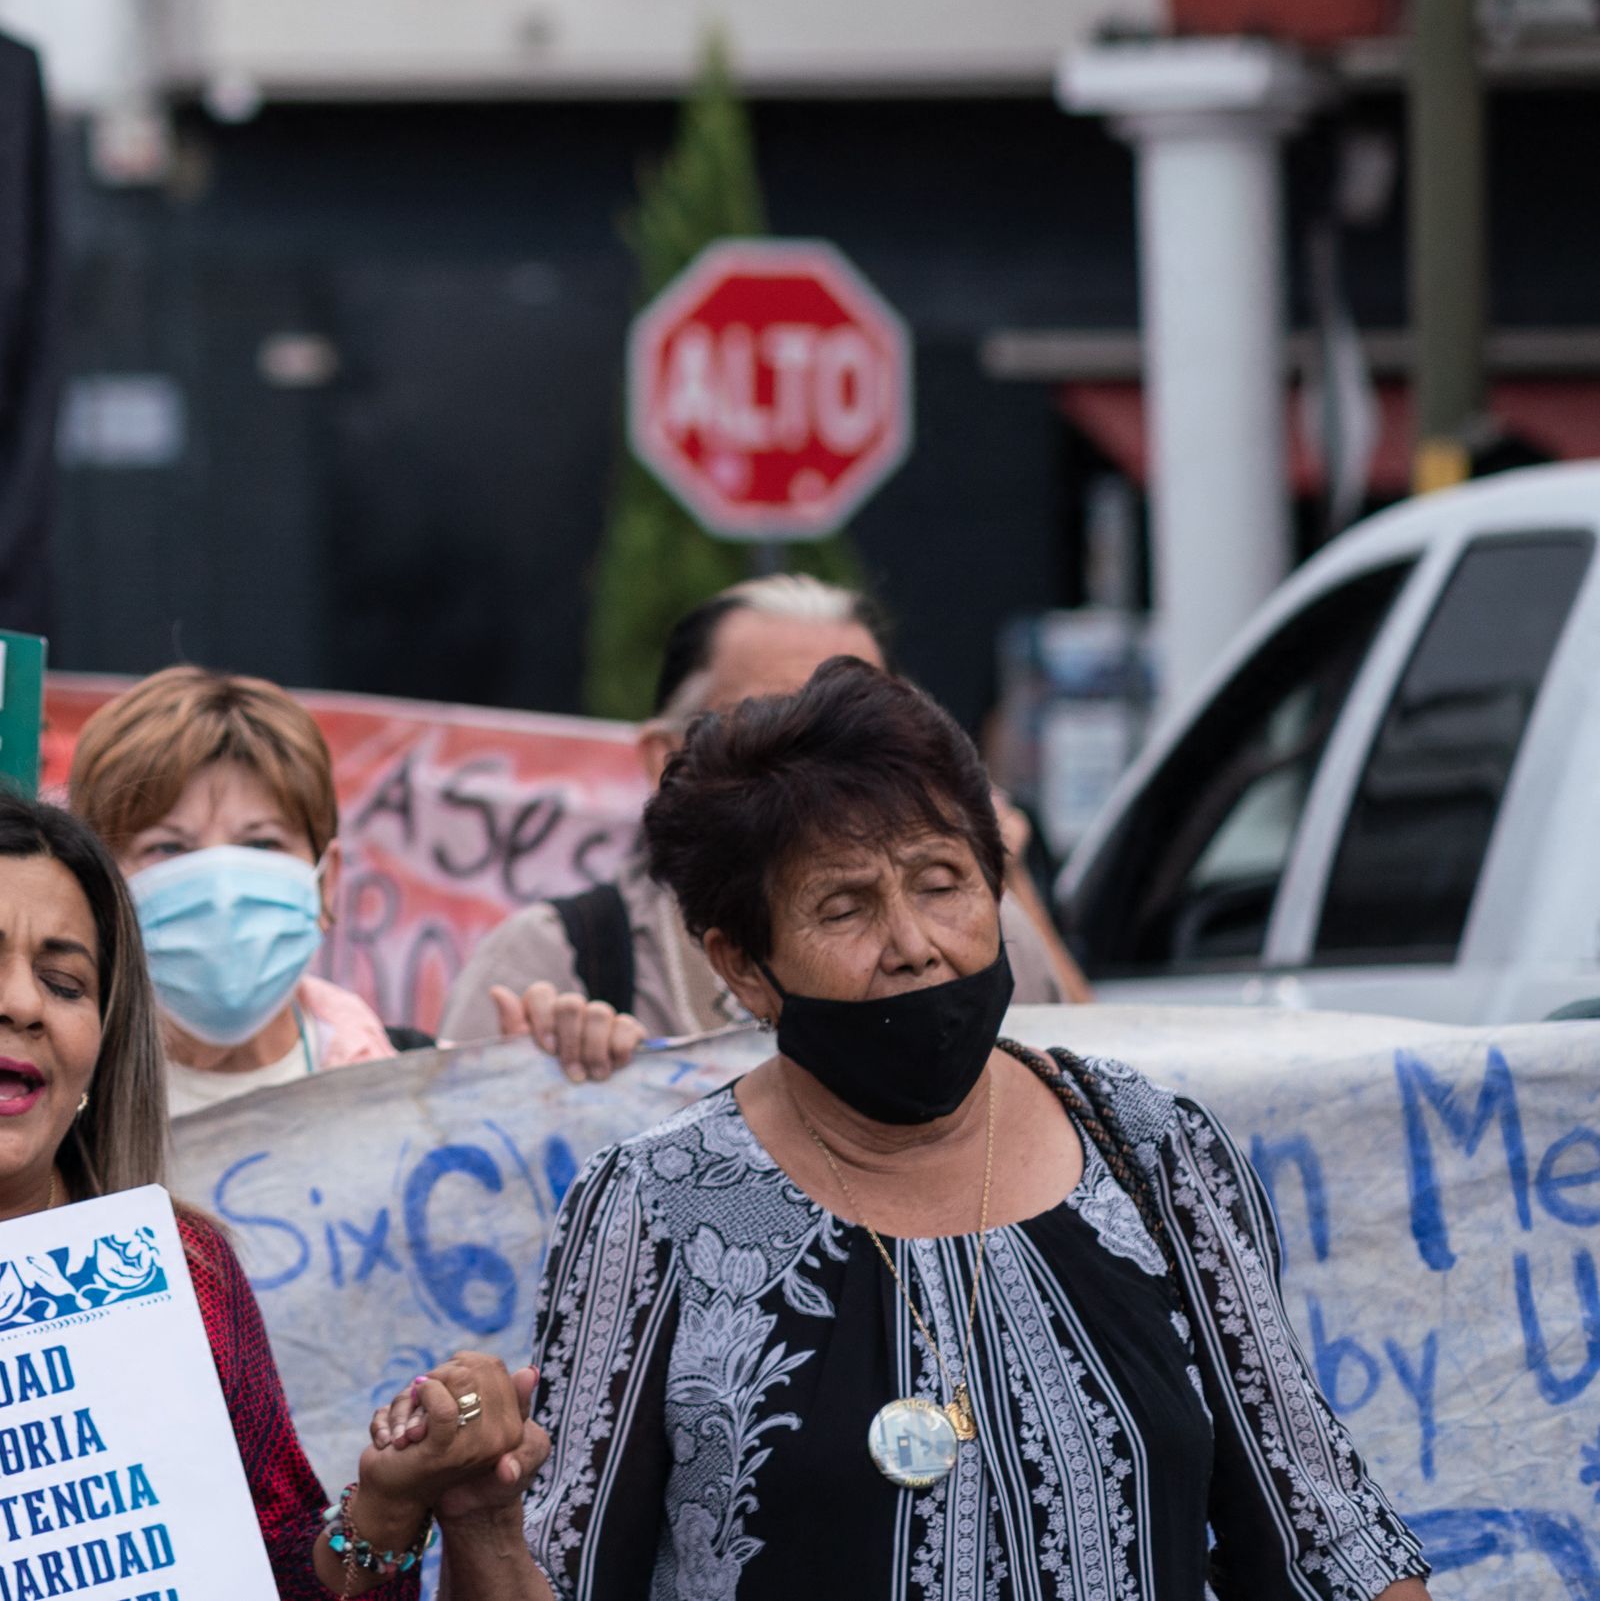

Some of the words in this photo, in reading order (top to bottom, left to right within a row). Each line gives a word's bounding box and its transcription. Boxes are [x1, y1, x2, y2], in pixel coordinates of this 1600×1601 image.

[666, 321, 882, 453] ALTO
[213, 1150, 402, 1291] Six
[1307, 1292, 1440, 1482] by
